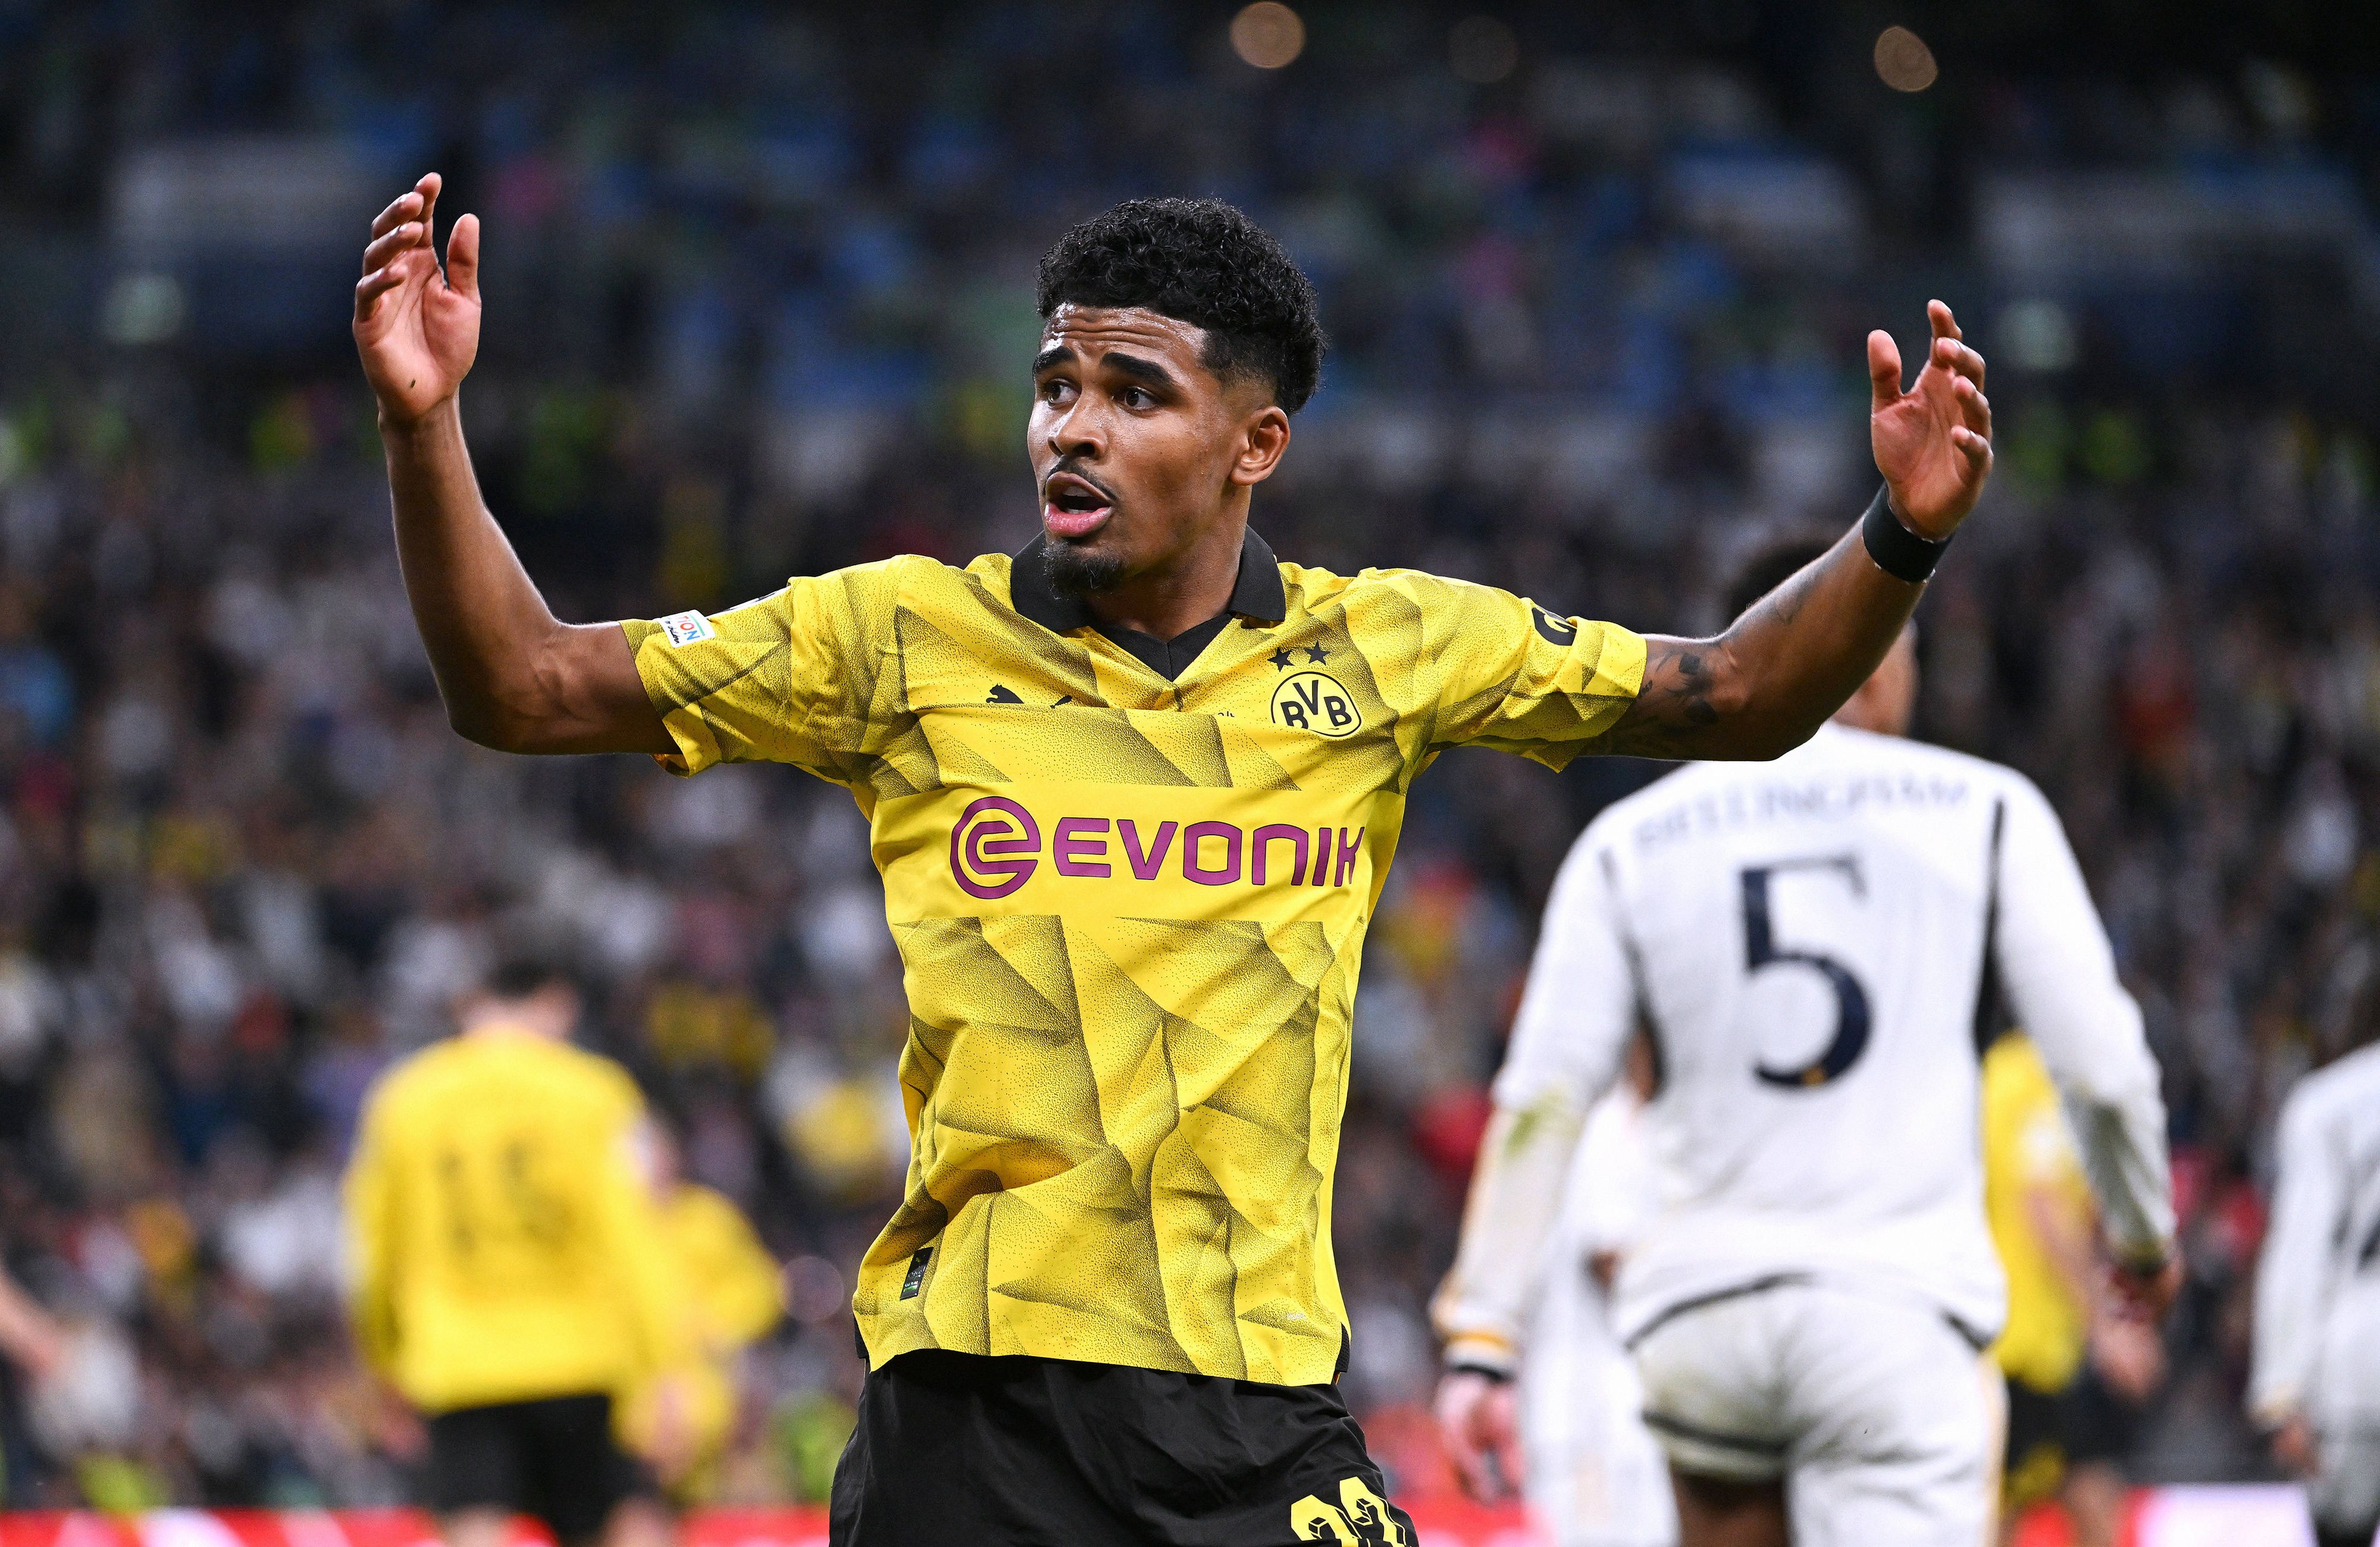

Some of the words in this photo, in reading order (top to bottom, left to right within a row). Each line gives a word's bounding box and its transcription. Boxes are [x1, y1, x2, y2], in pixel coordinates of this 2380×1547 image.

[1280, 679, 1352, 730] BVB
[1053, 817, 1366, 887] EVONIK
[1740, 853, 1874, 1090] 5
